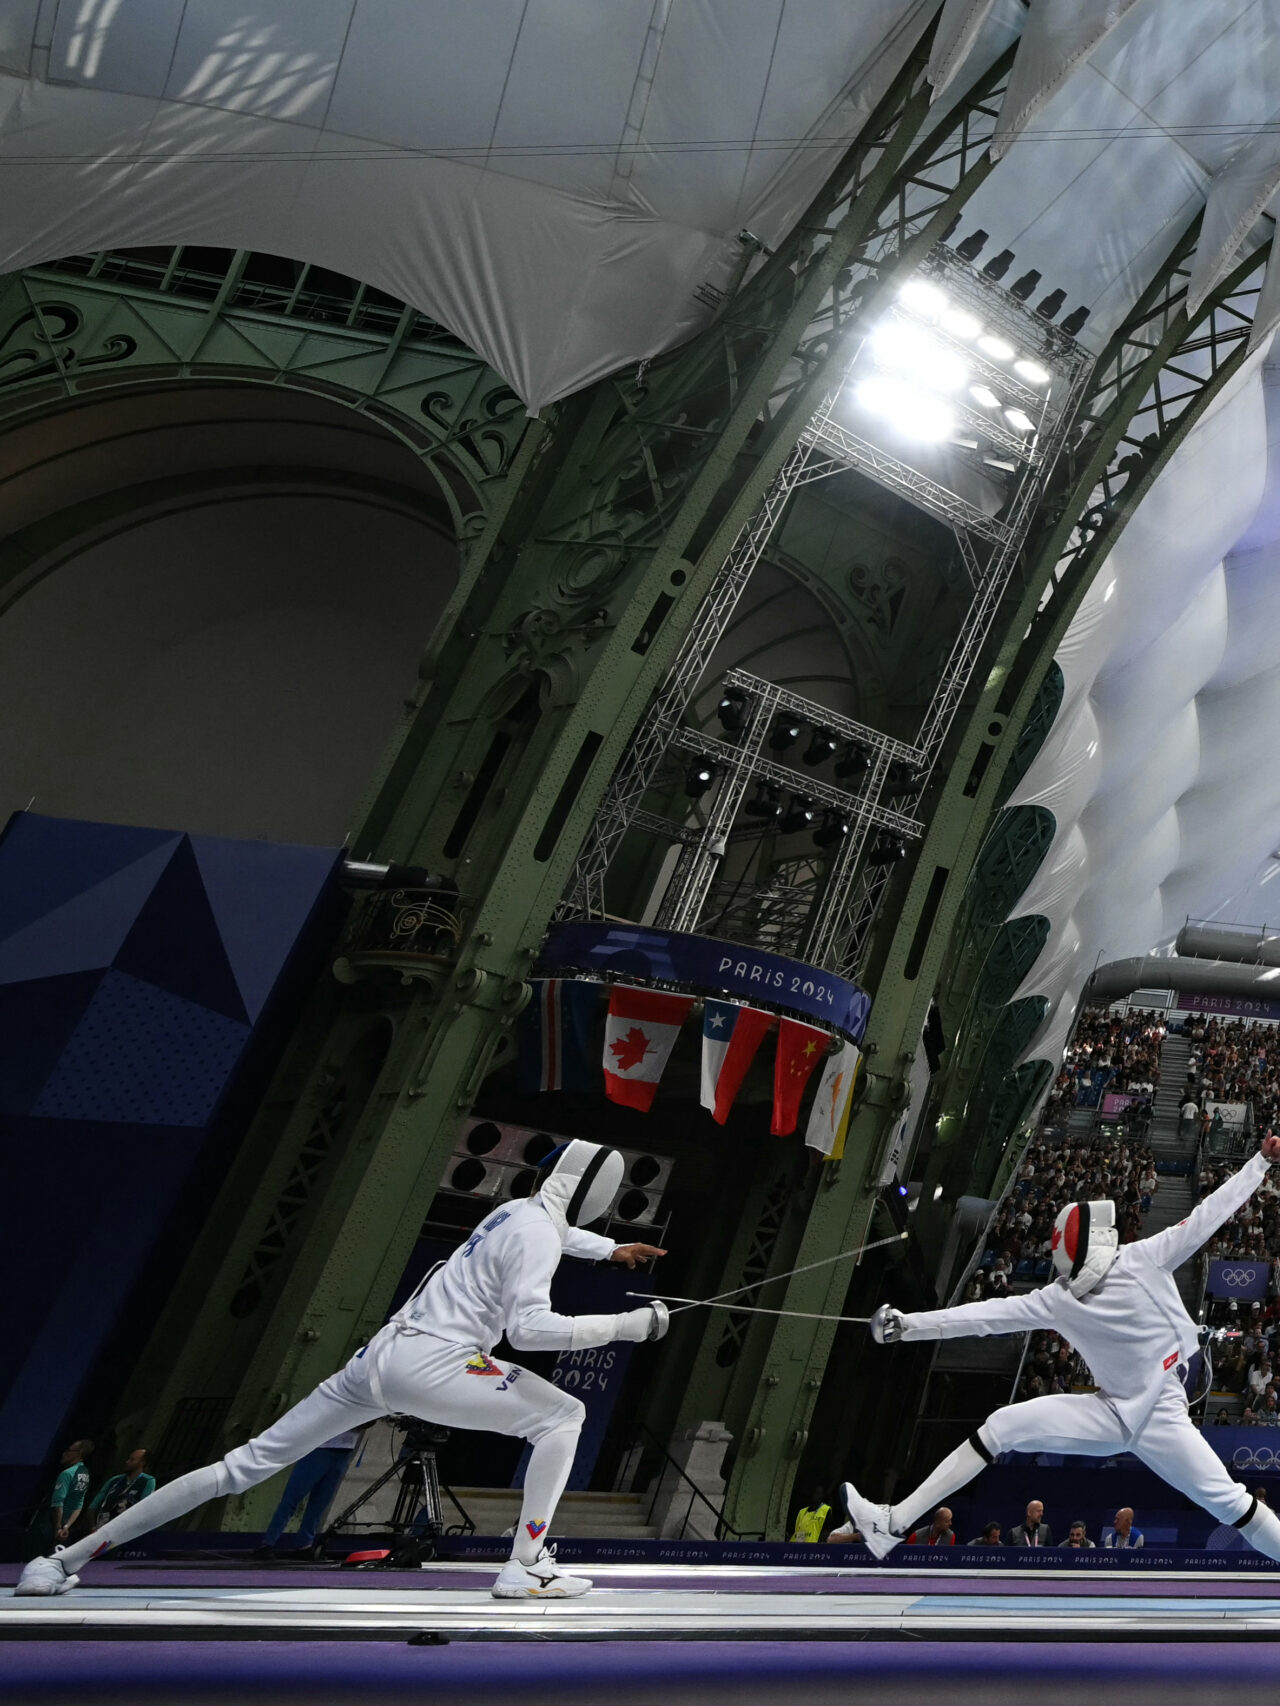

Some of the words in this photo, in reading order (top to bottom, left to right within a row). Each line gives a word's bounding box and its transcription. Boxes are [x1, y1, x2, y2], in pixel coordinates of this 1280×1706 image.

[1193, 996, 1232, 1008] PARIS
[1236, 1001, 1270, 1012] 2024
[556, 1349, 616, 1369] PARIS
[496, 1366, 522, 1391] VEN
[551, 1368, 608, 1391] 2024
[596, 1548, 621, 1556] PARIS
[623, 1549, 646, 1557] 2024
[748, 1552, 770, 1560] 2024
[783, 1552, 807, 1561] PARIS
[809, 1553, 831, 1561] 2024
[986, 1555, 1006, 1563] 2024
[1098, 1557, 1119, 1565] 2024
[1153, 1558, 1173, 1566] 2024
[1184, 1558, 1206, 1566] PARIS
